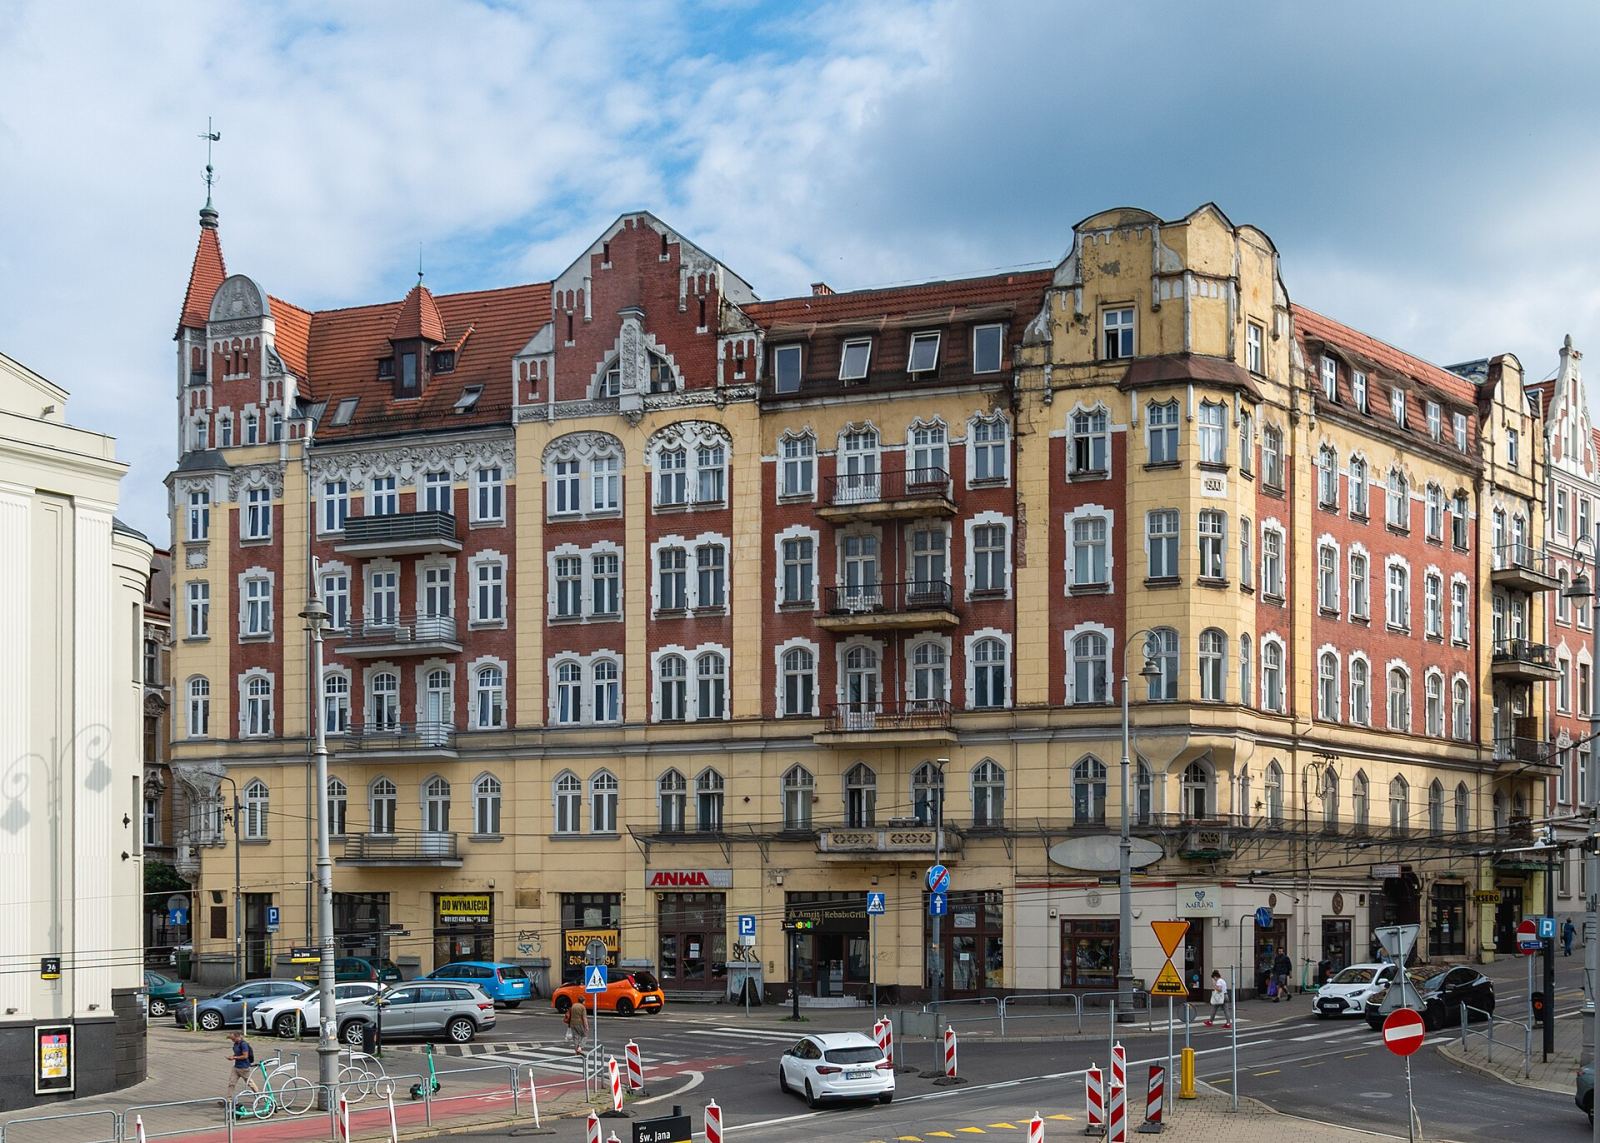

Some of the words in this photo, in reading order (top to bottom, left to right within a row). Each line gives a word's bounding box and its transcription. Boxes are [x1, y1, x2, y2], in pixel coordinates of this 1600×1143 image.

[651, 872, 709, 886] ANWA
[1475, 894, 1499, 902] KSERO
[442, 900, 451, 911] DO
[452, 900, 488, 912] WYNAJĘCIA
[742, 917, 752, 933] P
[1543, 920, 1552, 935] P
[567, 935, 616, 947] SPRZAM
[639, 1132, 652, 1142] św.
[654, 1131, 670, 1142] Jana
